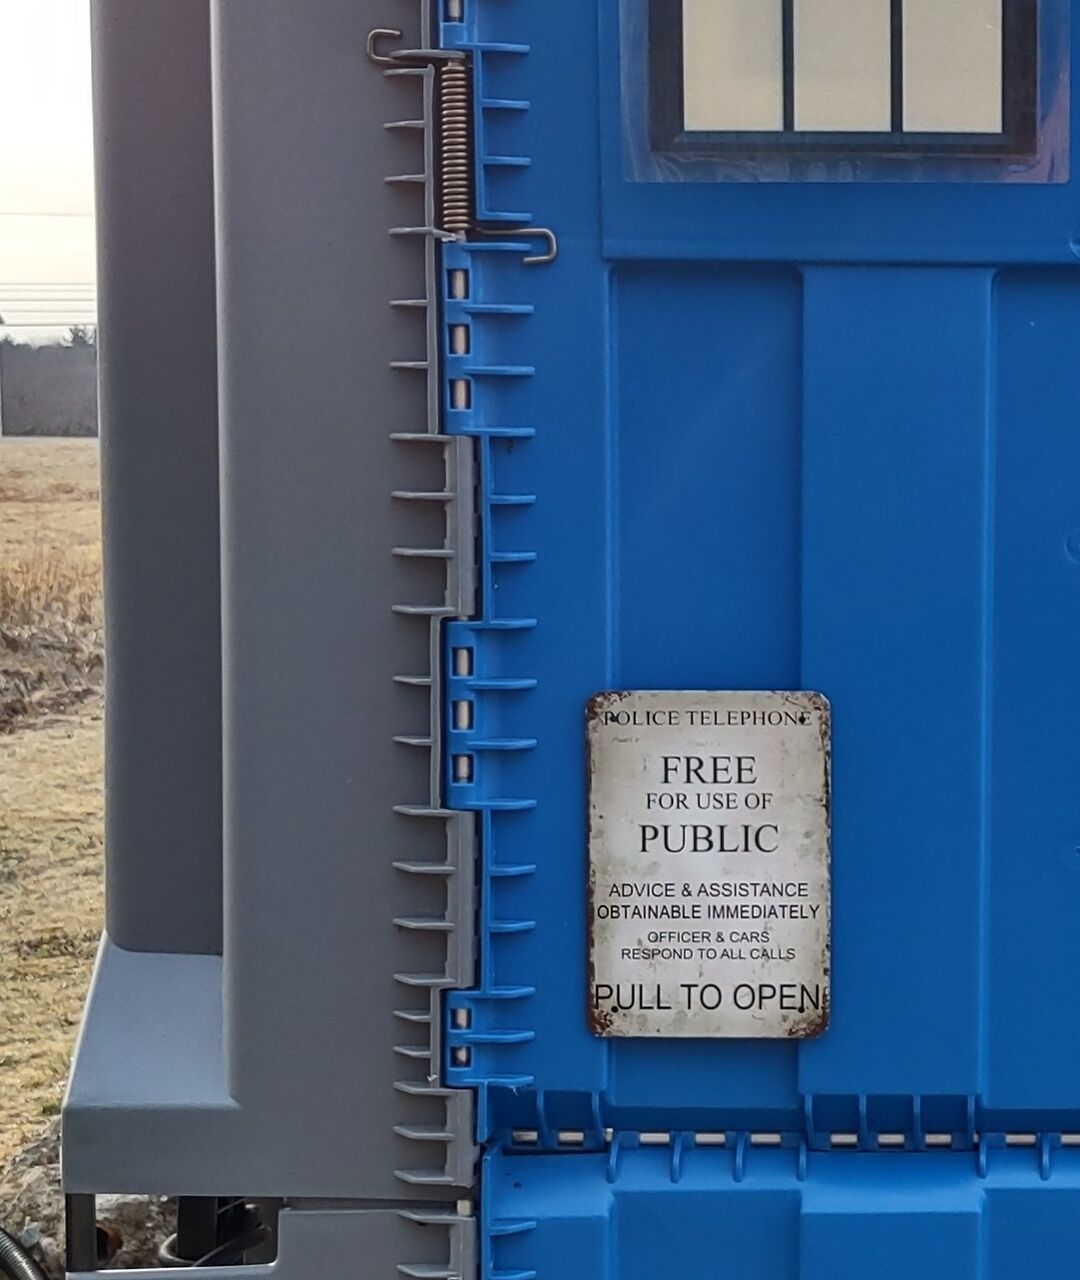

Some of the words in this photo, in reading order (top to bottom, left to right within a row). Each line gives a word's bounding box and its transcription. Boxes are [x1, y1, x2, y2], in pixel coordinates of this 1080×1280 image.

[603, 711, 680, 726] POLICE
[687, 711, 812, 726] TELEPHONE
[660, 756, 757, 785] FREE
[646, 792, 689, 810] FOR
[696, 792, 738, 810] USE
[745, 792, 773, 810] OF
[639, 824, 779, 853] PUBLIC
[609, 883, 677, 897] ADVICE
[682, 883, 692, 897] &
[697, 883, 808, 897] ASSISTANCE
[597, 905, 701, 919] OBTAINABLE
[707, 904, 820, 919] IMMEDIATELY
[648, 931, 712, 943] OFFICER
[717, 931, 725, 943] &
[730, 931, 770, 943] CARS
[621, 948, 693, 960] RESPOND
[699, 948, 717, 960] TO
[721, 948, 746, 960] ALL
[750, 948, 795, 960] CALLS
[595, 985, 671, 1010] PULL
[680, 984, 722, 1010] TO
[733, 984, 820, 1010] OPEN
